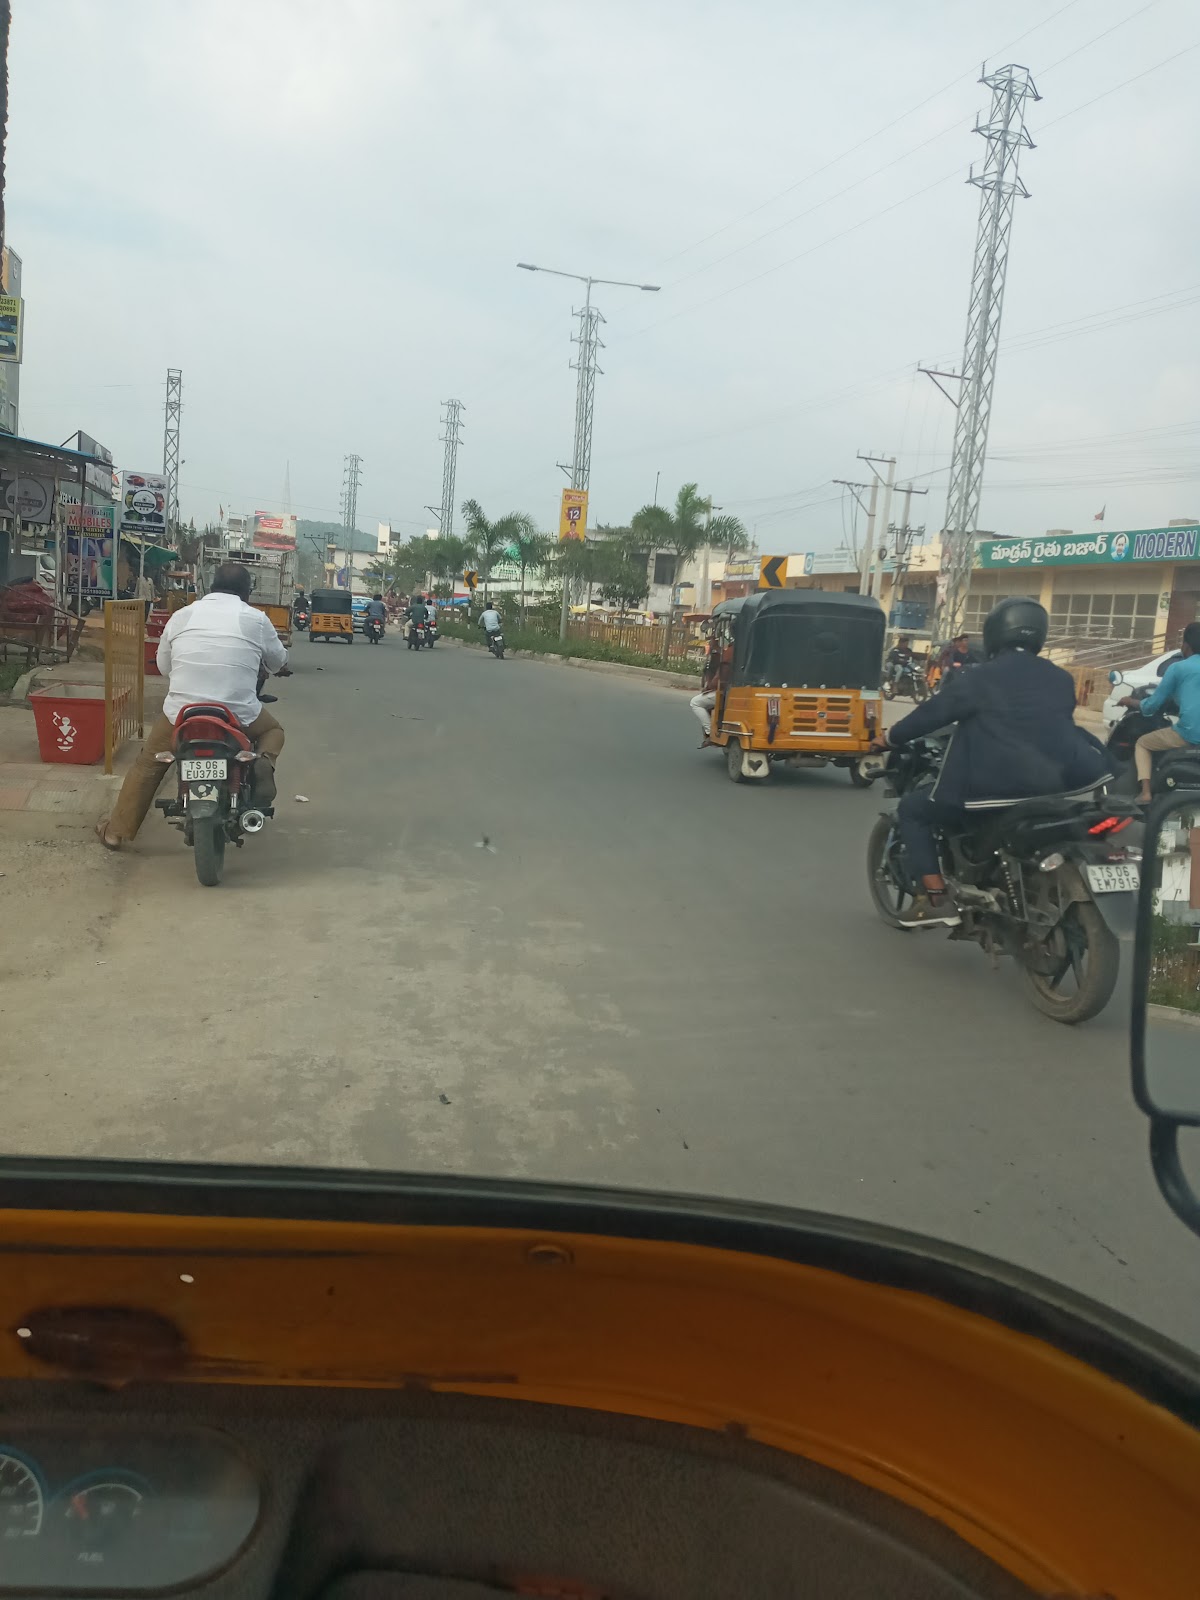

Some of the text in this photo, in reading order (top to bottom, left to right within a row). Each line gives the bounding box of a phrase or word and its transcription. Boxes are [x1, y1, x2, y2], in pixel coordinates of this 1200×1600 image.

[569, 509, 580, 520] 12
[68, 515, 112, 528] MOBILES
[1031, 541, 1062, 563] రైతు
[1063, 535, 1109, 556] బజార్
[1133, 530, 1198, 559] MODERN
[189, 761, 218, 770] TS 06
[186, 770, 225, 780] EU3789
[1098, 866, 1130, 878] TS 06
